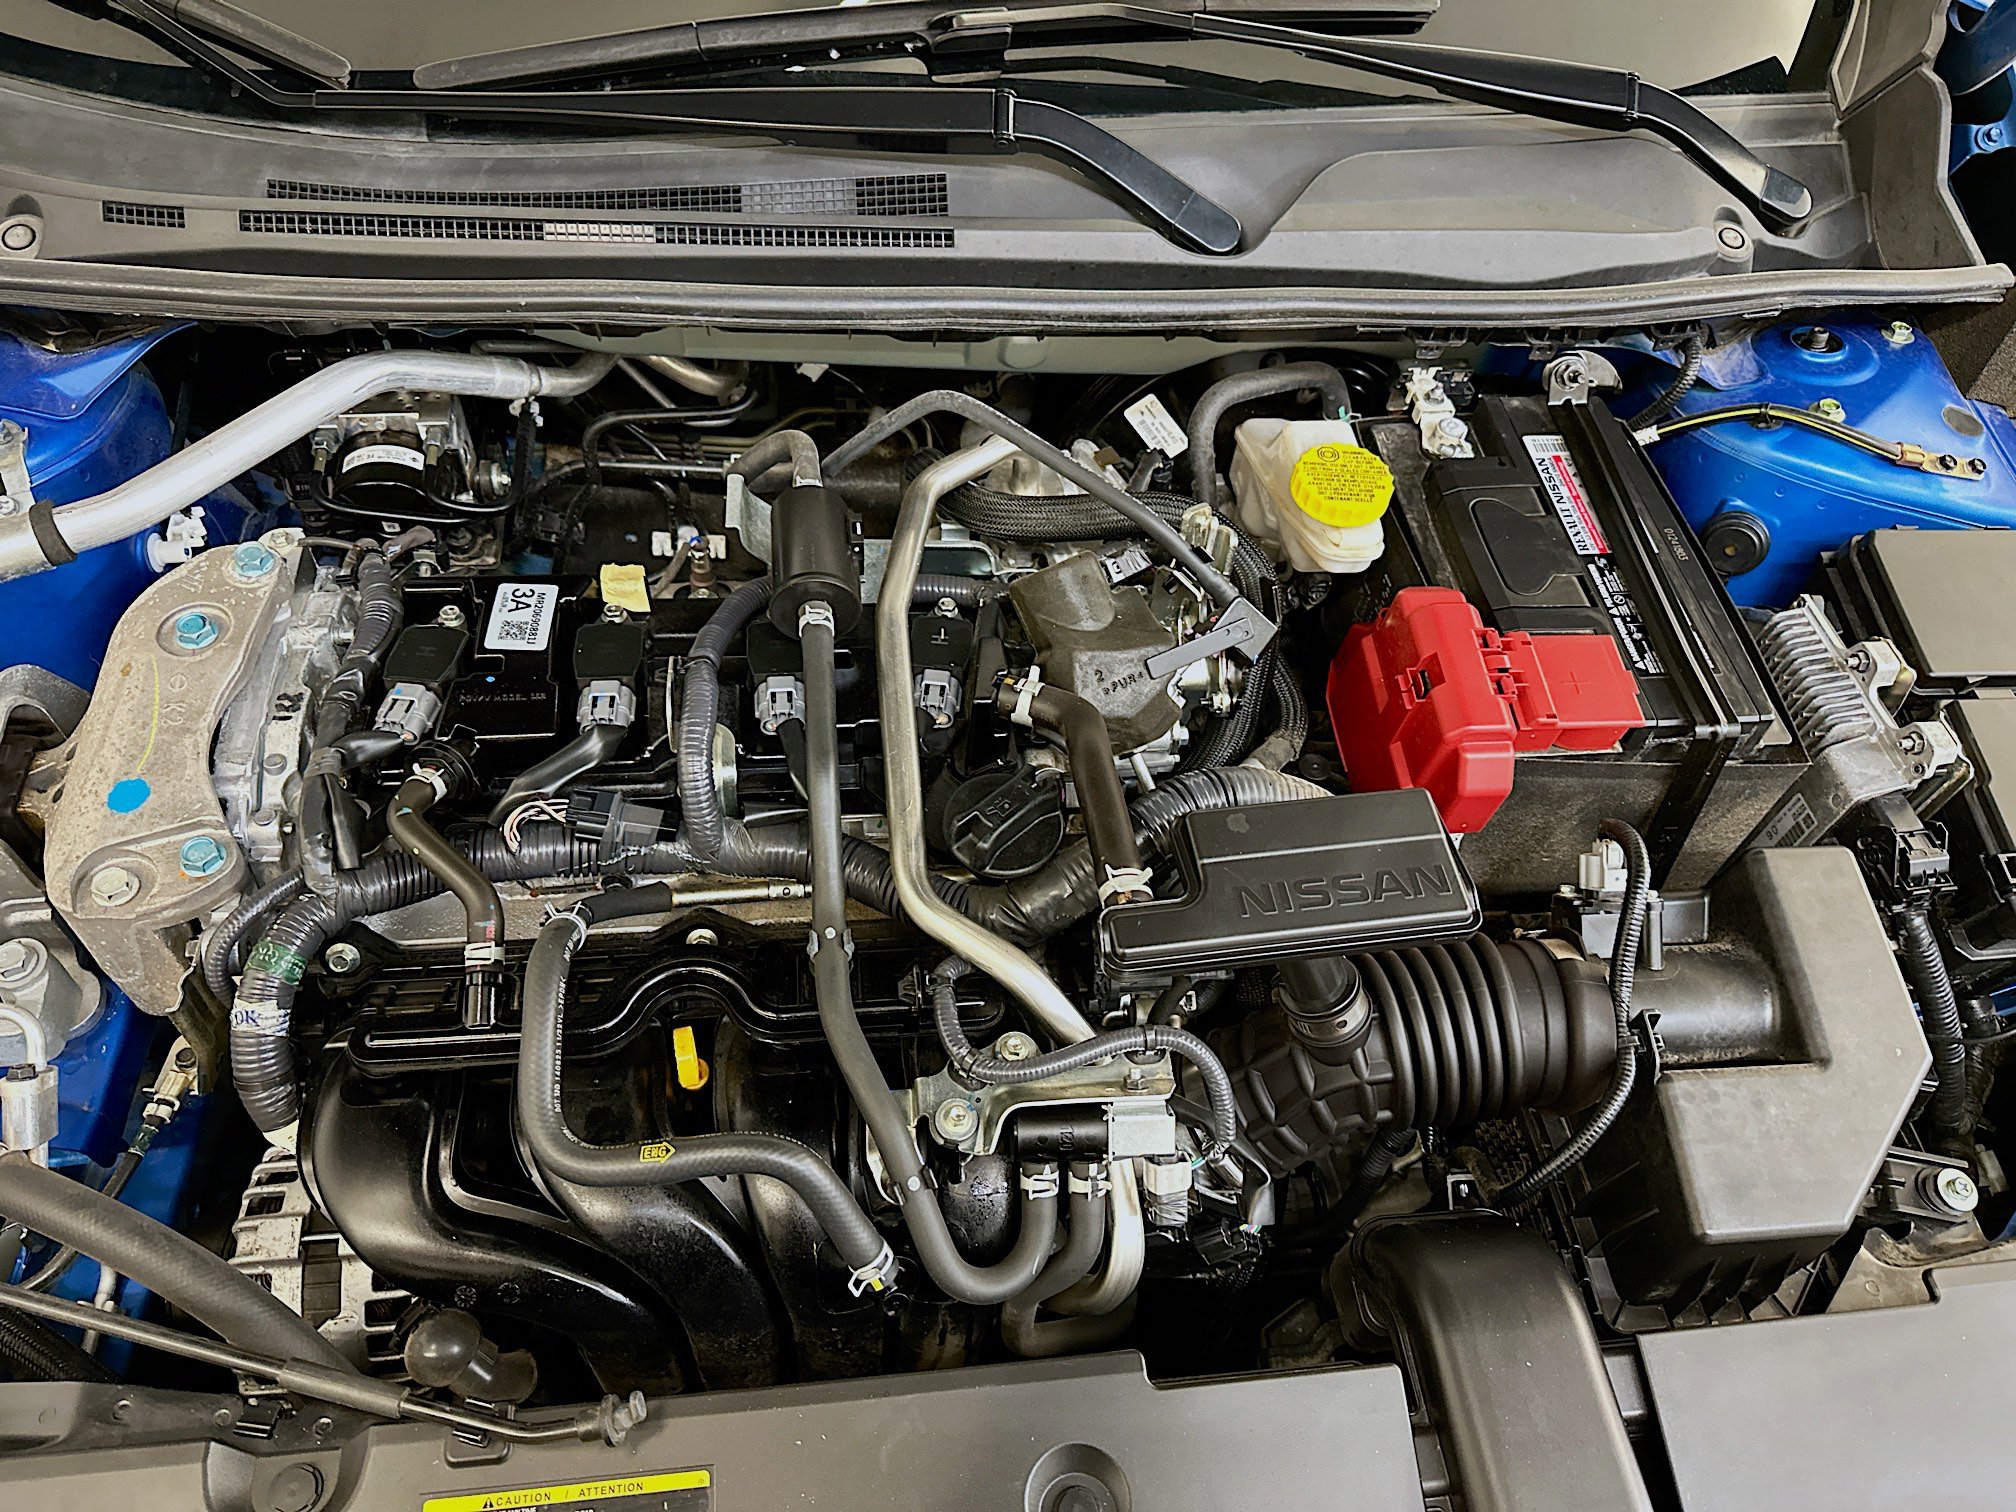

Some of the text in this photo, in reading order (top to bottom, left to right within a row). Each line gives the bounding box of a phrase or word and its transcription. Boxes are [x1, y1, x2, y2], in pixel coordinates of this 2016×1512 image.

[1536, 457, 1566, 504] NISSAN
[1560, 507, 1590, 551] RENAULT
[507, 588, 536, 613] 3A
[1235, 864, 1452, 917] NISSAN
[643, 1147, 667, 1159] ENG
[496, 1492, 551, 1507] CAUTION
[578, 1482, 644, 1498] ATTENTION
